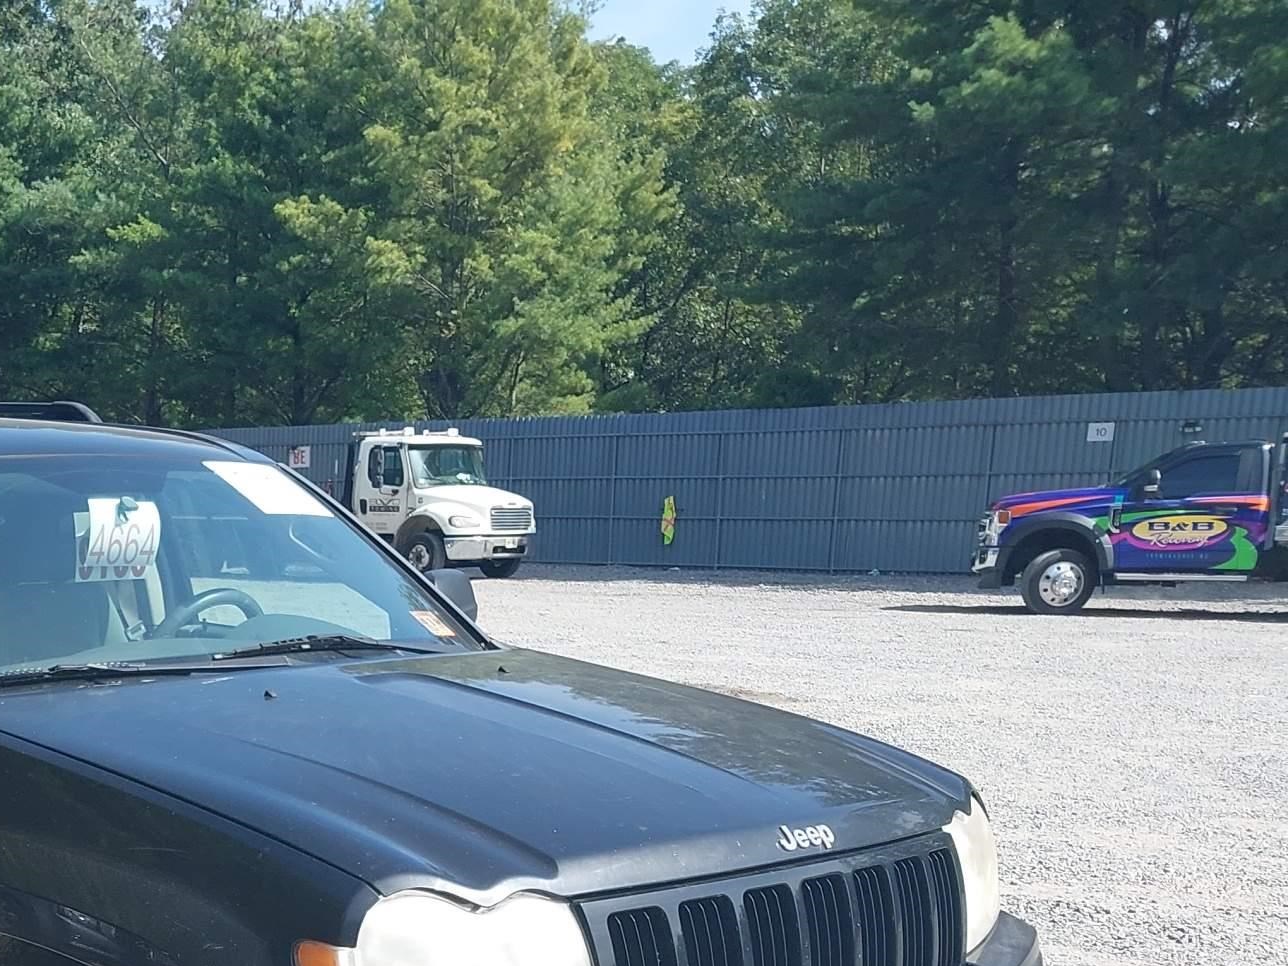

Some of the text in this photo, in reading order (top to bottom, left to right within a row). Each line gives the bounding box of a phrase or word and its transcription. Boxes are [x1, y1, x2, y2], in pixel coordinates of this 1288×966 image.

[1096, 427, 1108, 438] 10
[293, 450, 306, 465] BE
[1148, 521, 1215, 532] B&B
[89, 523, 155, 565] 4664
[778, 824, 835, 851] Jeep
